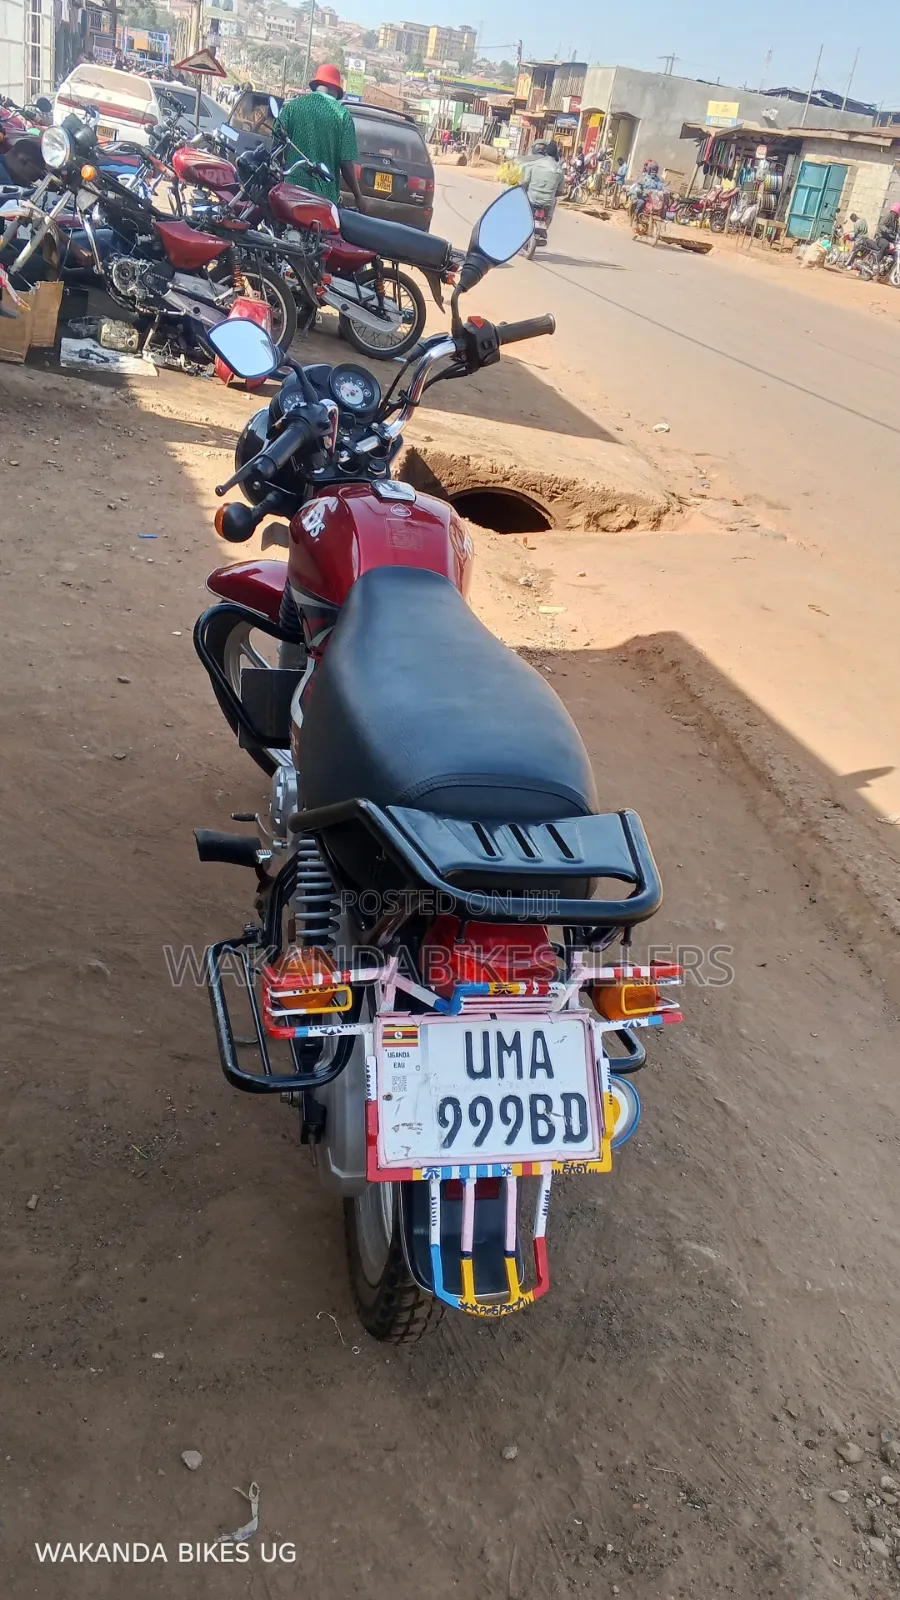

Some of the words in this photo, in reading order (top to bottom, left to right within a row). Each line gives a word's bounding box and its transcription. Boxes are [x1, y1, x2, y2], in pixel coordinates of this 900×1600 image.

[387, 1051, 411, 1059] UGANDA
[393, 1061, 406, 1069] EAU
[464, 1029, 555, 1081] UMA
[437, 1092, 589, 1149] 999BD
